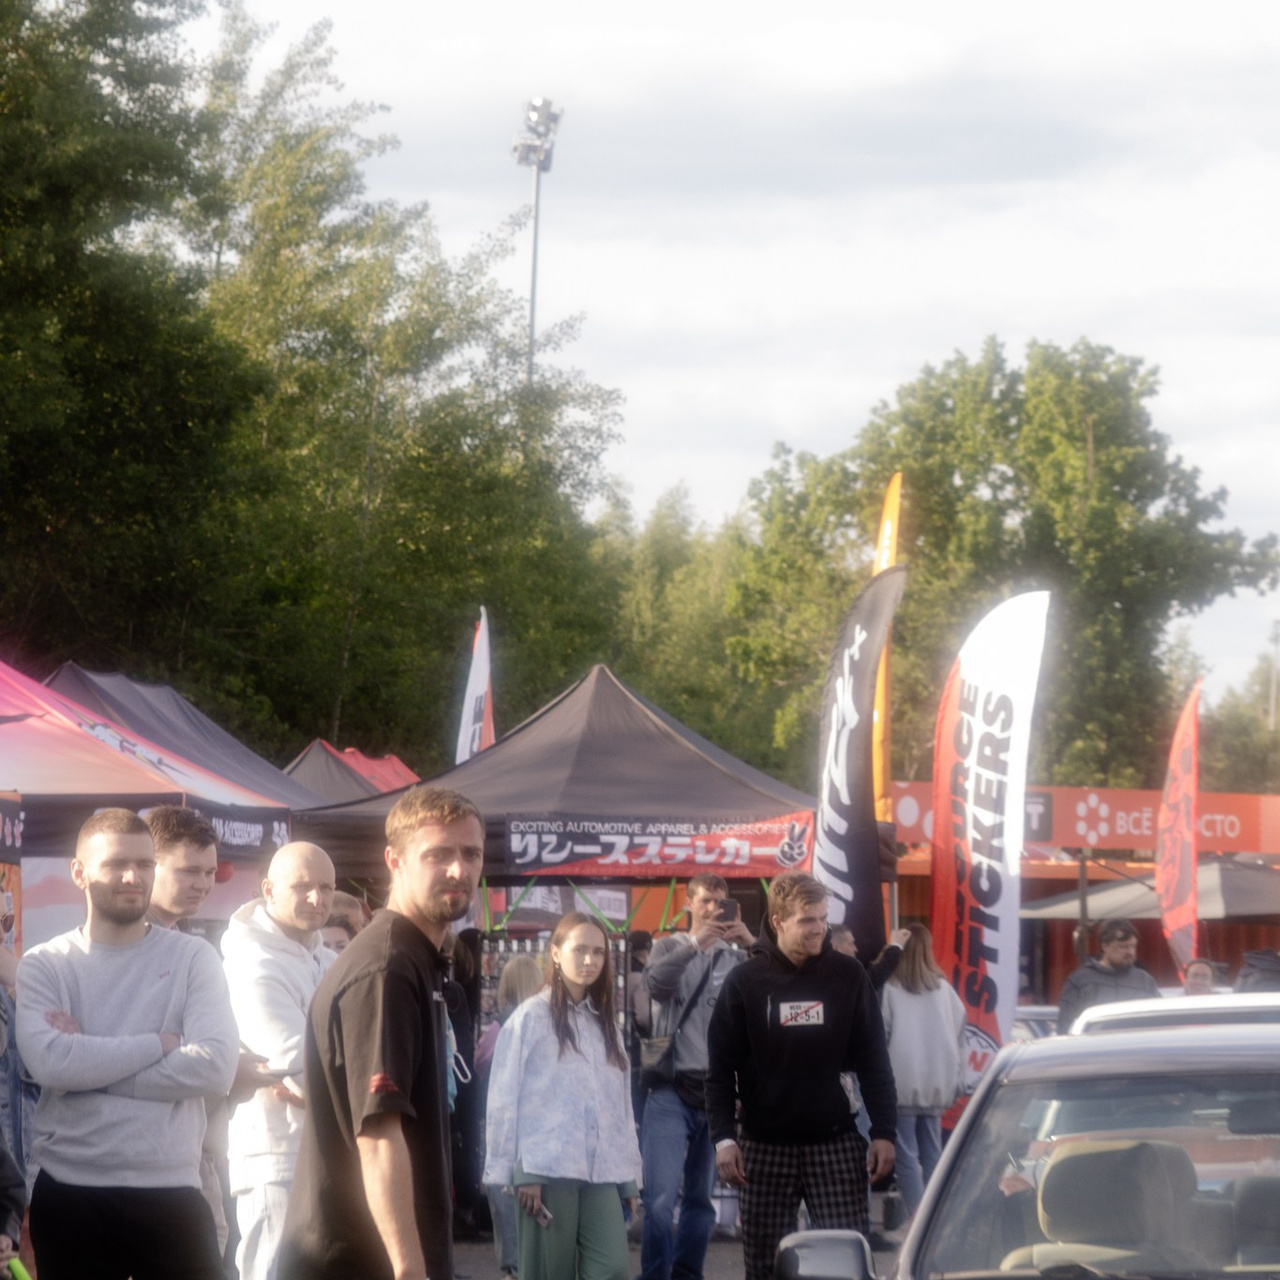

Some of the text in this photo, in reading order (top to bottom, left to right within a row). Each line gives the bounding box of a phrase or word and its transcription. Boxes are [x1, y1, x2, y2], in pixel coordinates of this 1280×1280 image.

[510, 821, 789, 836] EXCITING AUTOMOTIVE APPAREL & ACCESSORIES
[1115, 806, 1153, 836] ВСЁ
[964, 691, 1014, 1013] STICKERS
